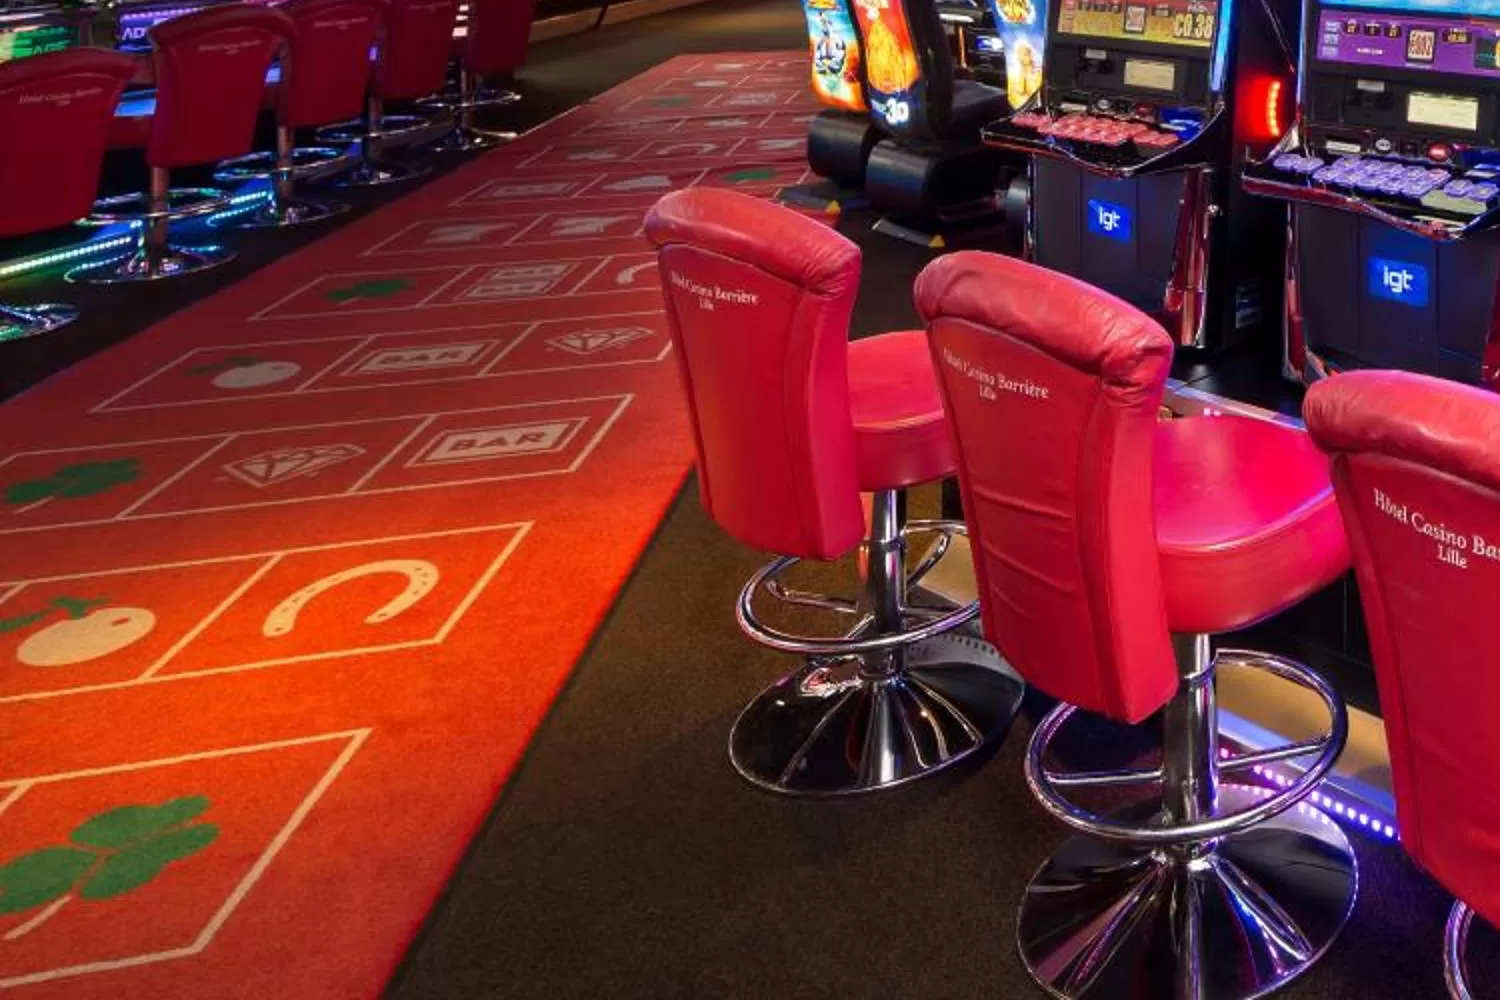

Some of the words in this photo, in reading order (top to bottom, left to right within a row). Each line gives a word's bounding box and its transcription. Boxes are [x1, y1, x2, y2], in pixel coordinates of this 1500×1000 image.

[1383, 265, 1414, 293] igt
[449, 430, 549, 452] BAR
[1411, 512, 1468, 549] Casino
[1437, 545, 1468, 569] Lille
